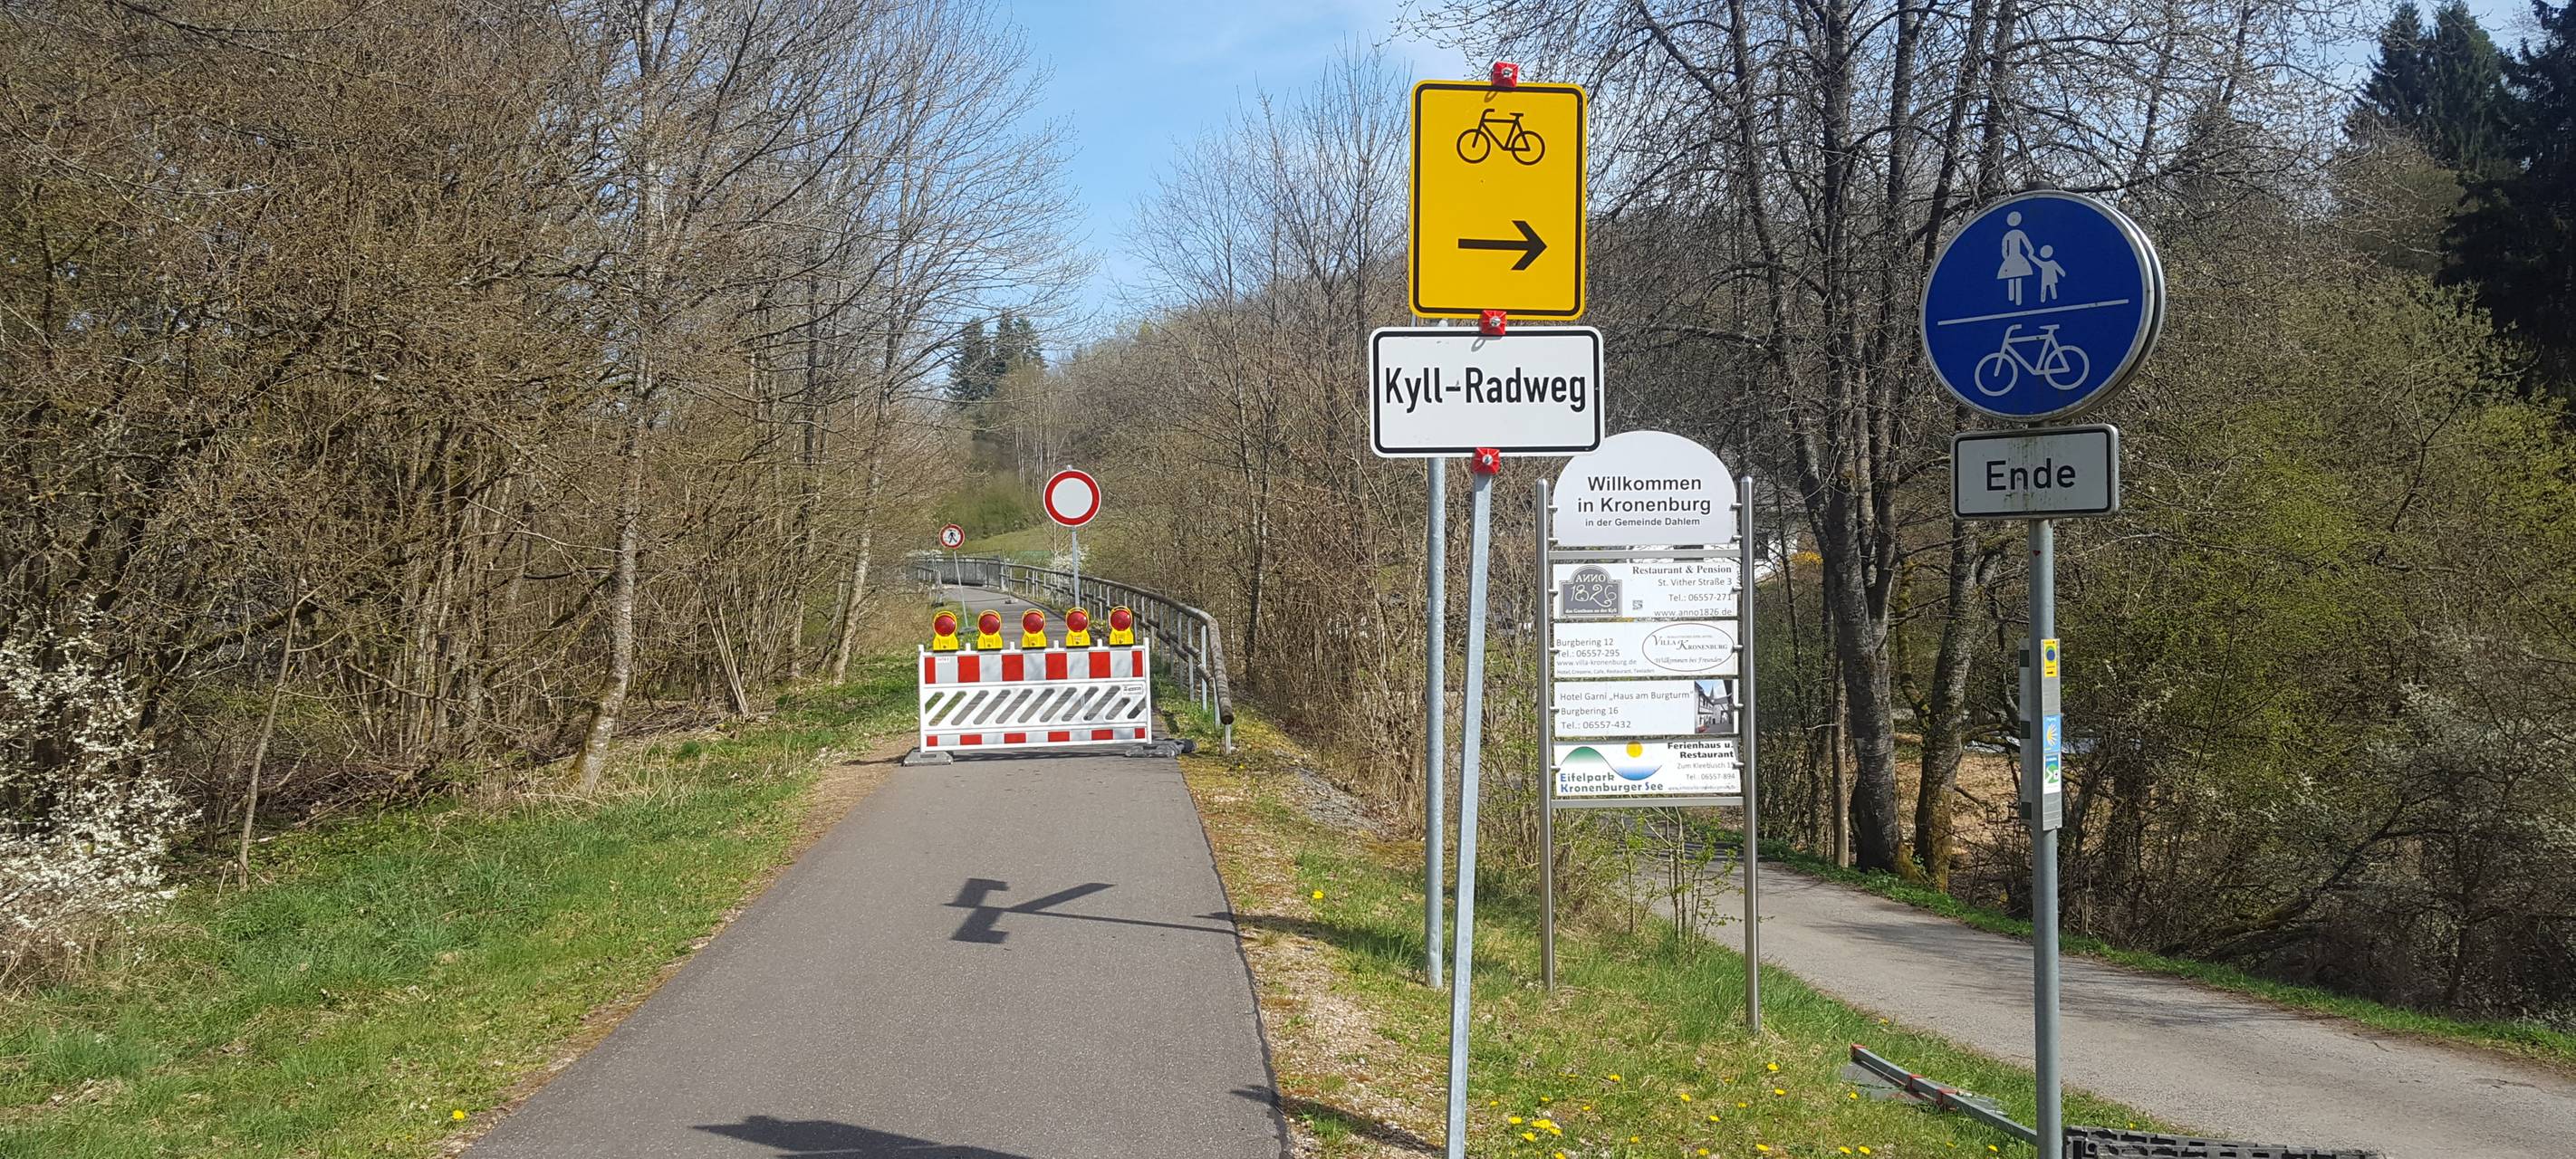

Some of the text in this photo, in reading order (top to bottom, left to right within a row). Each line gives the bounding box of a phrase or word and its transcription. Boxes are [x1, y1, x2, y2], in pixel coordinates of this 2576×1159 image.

[1385, 367, 1585, 413] Kyll-Radweg
[1986, 457, 2076, 491] Ende
[1587, 476, 1702, 491] Willkommen
[1578, 497, 1711, 514] in Kronenburg
[1585, 517, 1700, 527] in der Gemeinde Dahlem
[1632, 565, 1732, 575] Restaurant & Pension
[1658, 578, 1733, 587] St. Vither Straße 3
[1570, 584, 1617, 608] 1826
[1668, 593, 1733, 602] Tel.: 06557-271
[1654, 608, 1732, 617] www.anno1826.de
[1556, 637, 1614, 647] Burgbering 12
[1576, 649, 1620, 657] 06557-295
[1560, 693, 1582, 701] Hotel
[1584, 692, 1607, 701] Garni
[1561, 707, 1606, 716] Burgbering
[1582, 721, 1631, 729] 06557-432
[1668, 742, 1721, 750] Ferienhaus
[1679, 751, 1734, 759] Restaurant
[1560, 772, 1615, 783] Eifelpark
[1561, 783, 1642, 792] Kronenburger
[1645, 781, 1664, 790] See
